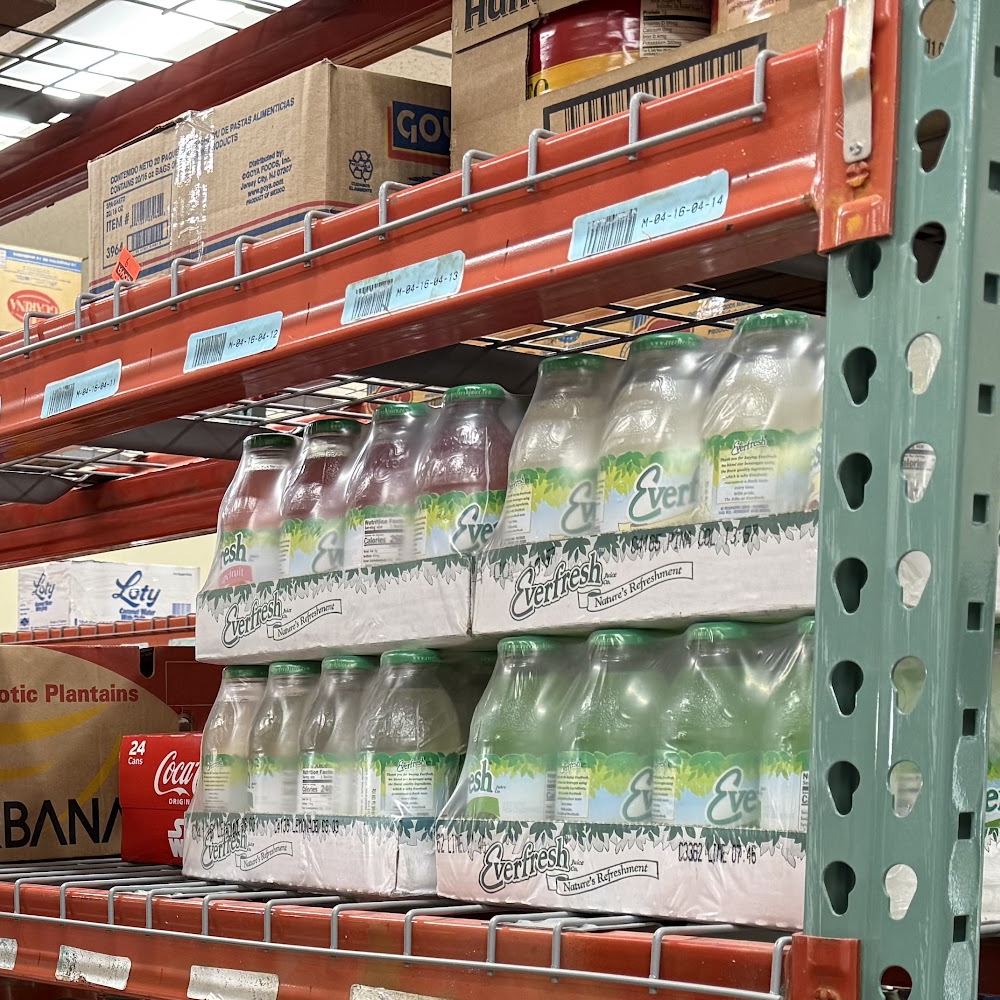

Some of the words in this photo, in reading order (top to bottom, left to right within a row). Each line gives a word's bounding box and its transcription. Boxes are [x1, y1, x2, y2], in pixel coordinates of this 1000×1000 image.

[229, 116, 252, 133] PASTAS
[253, 97, 295, 124] ALIMENTICIAS
[110, 165, 139, 184] CONTENIDO
[139, 160, 153, 173] NETO
[249, 151, 276, 168] Distributed
[110, 178, 134, 195] CONTAINS
[155, 164, 171, 176] BAGS
[106, 216, 123, 233] ITEM
[641, 194, 724, 228] M-04-16-04-14
[395, 271, 459, 297] M-04-16-04-13
[228, 329, 279, 349] M-04-16-04-12
[112, 569, 161, 608] Loty
[509, 551, 603, 621] Everfresh
[594, 587, 628, 609] Nature's
[629, 566, 683, 592] Refreshment
[221, 591, 283, 648] Everfresh
[277, 619, 300, 638] Nature's
[45, 683, 139, 704] Plantains
[128, 756, 144, 766] Cans
[129, 740, 146, 756] 24
[479, 836, 570, 893] Everfresh
[563, 876, 596, 894] Nature's
[596, 863, 649, 885] Refreshment
